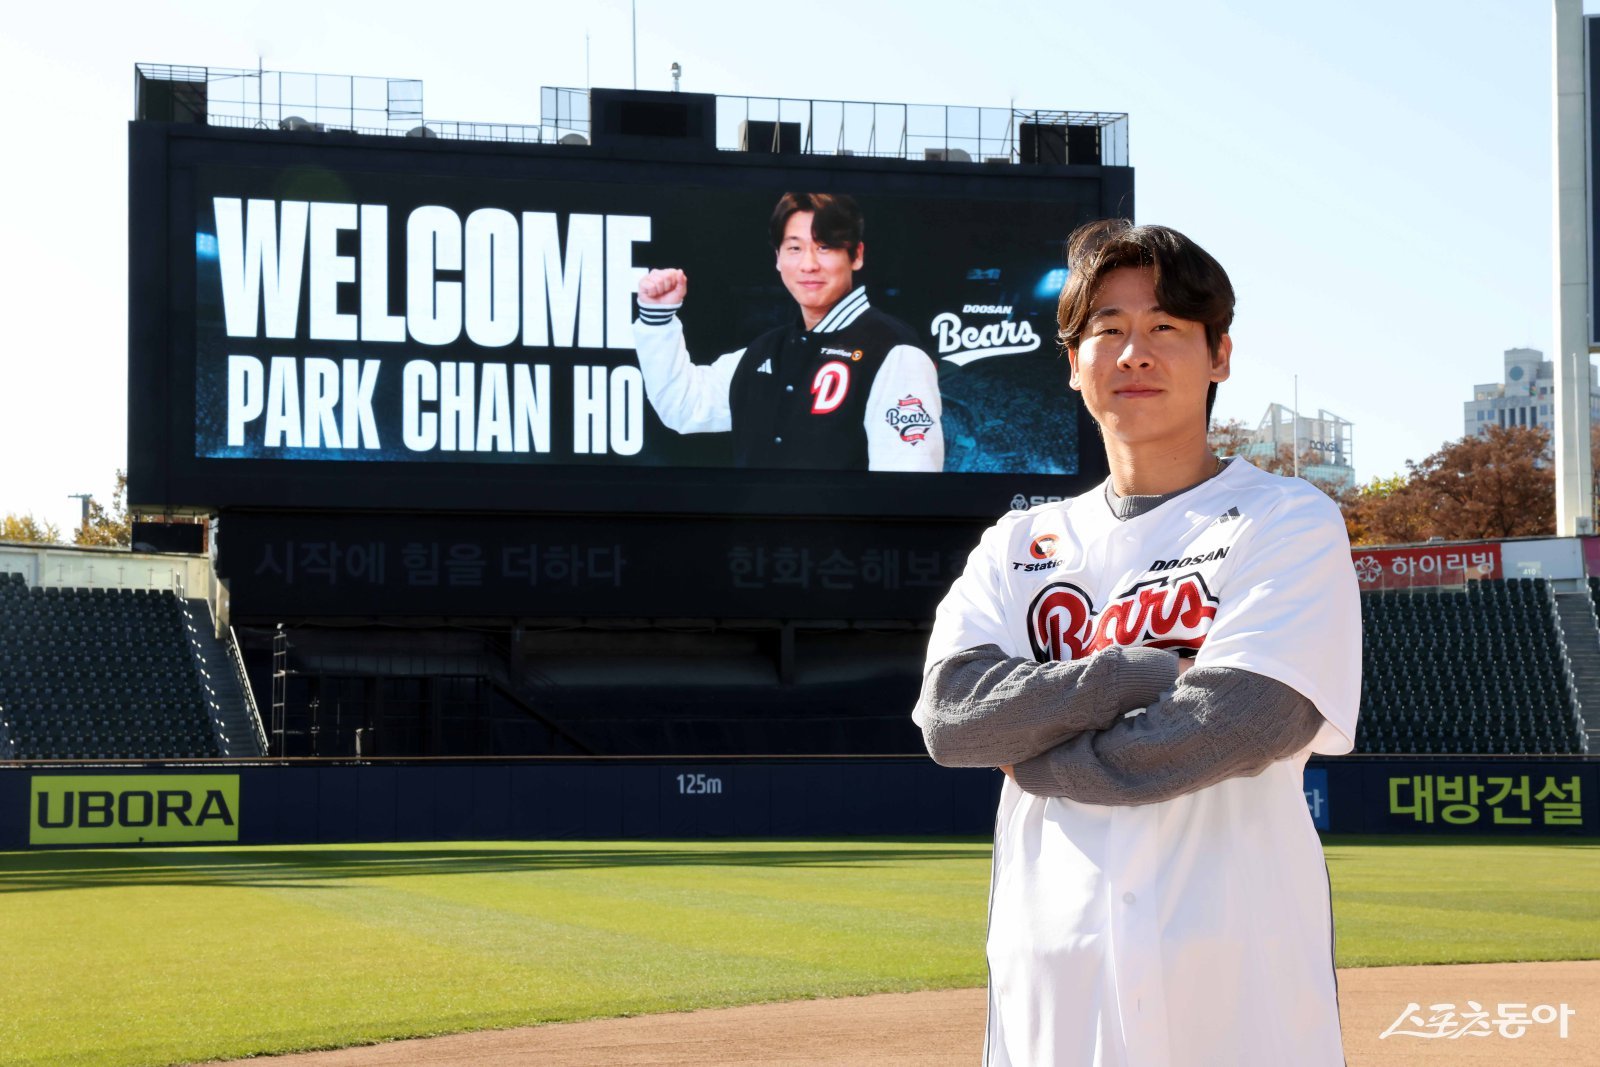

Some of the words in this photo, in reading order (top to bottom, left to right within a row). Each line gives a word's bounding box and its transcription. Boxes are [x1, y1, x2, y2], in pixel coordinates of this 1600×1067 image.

[213, 197, 651, 350] WELCOME
[962, 304, 1013, 314] DOOSAN
[931, 312, 1041, 364] Bears
[227, 354, 382, 450] PARK
[402, 359, 551, 453] CHAN
[573, 365, 644, 456] HO
[811, 360, 850, 414] D
[886, 408, 934, 428] Bears
[254, 541, 386, 585] 시작에
[401, 543, 488, 586] 힘을
[501, 544, 628, 587] 더하다
[1149, 546, 1231, 572] DOOSAN
[1392, 551, 1495, 576] 하이리빙
[1029, 574, 1217, 662] Bars
[676, 773, 722, 794] 125m
[1389, 775, 1583, 825] 대방건설
[37, 790, 234, 828] UBORA
